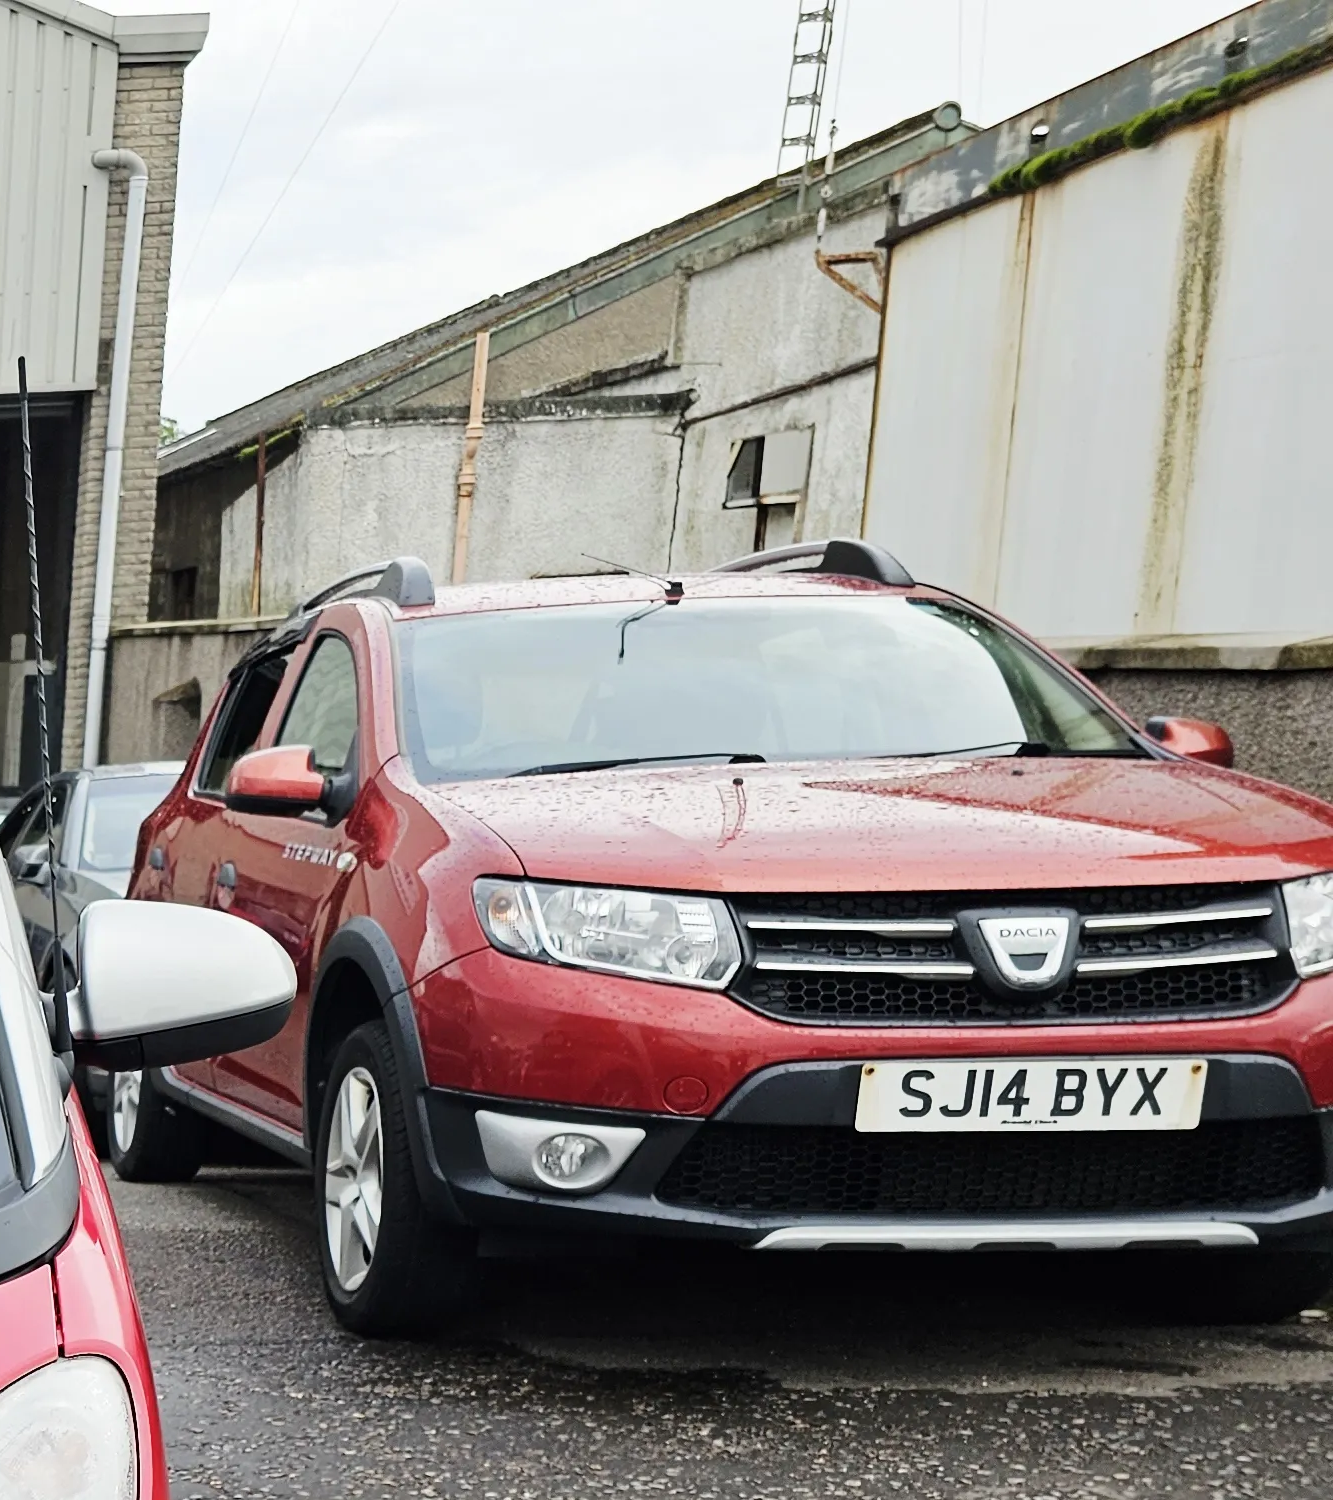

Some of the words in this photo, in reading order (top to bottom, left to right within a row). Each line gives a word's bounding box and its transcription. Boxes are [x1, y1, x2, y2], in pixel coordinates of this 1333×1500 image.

[282, 842, 339, 867] STEPWAY
[999, 928, 1057, 938] DACIA
[898, 1069, 1031, 1118] SJ14
[1049, 1067, 1169, 1117] BYX
